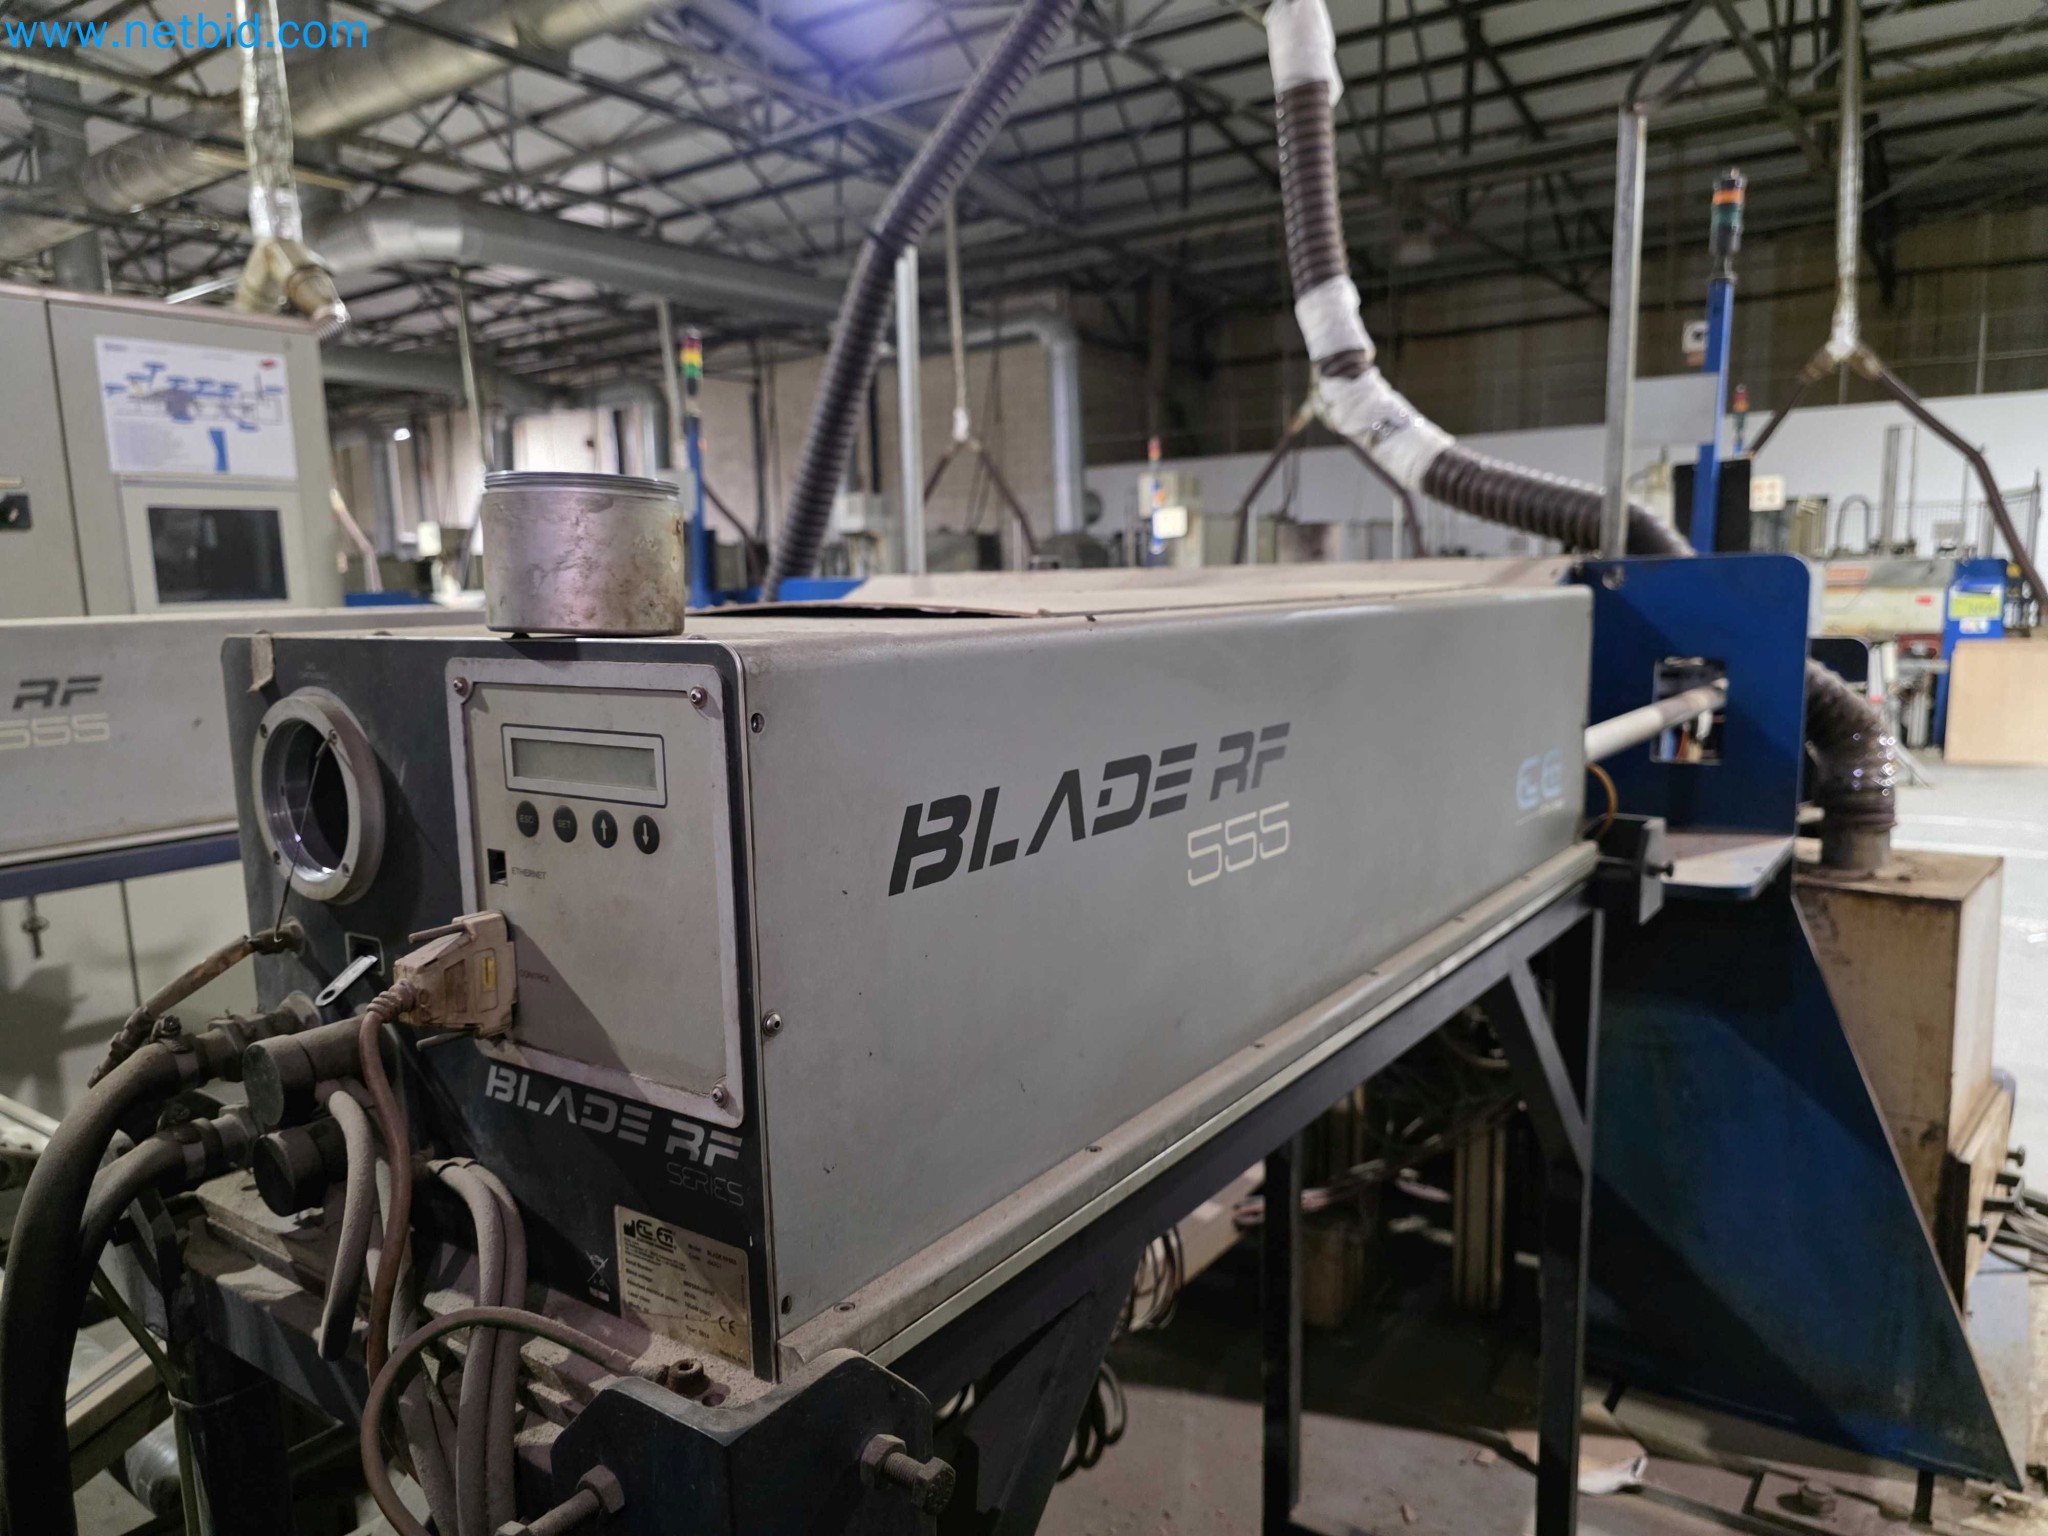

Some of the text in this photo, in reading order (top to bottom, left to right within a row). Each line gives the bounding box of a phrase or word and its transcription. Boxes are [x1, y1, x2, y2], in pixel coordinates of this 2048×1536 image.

[12, 675, 102, 711] RF
[888, 722, 1291, 897] BLADE RF
[511, 866, 547, 880] ETHERNET
[1187, 801, 1290, 887] 555
[484, 1064, 743, 1167] BLADE RF
[666, 1161, 744, 1207] SERIES
